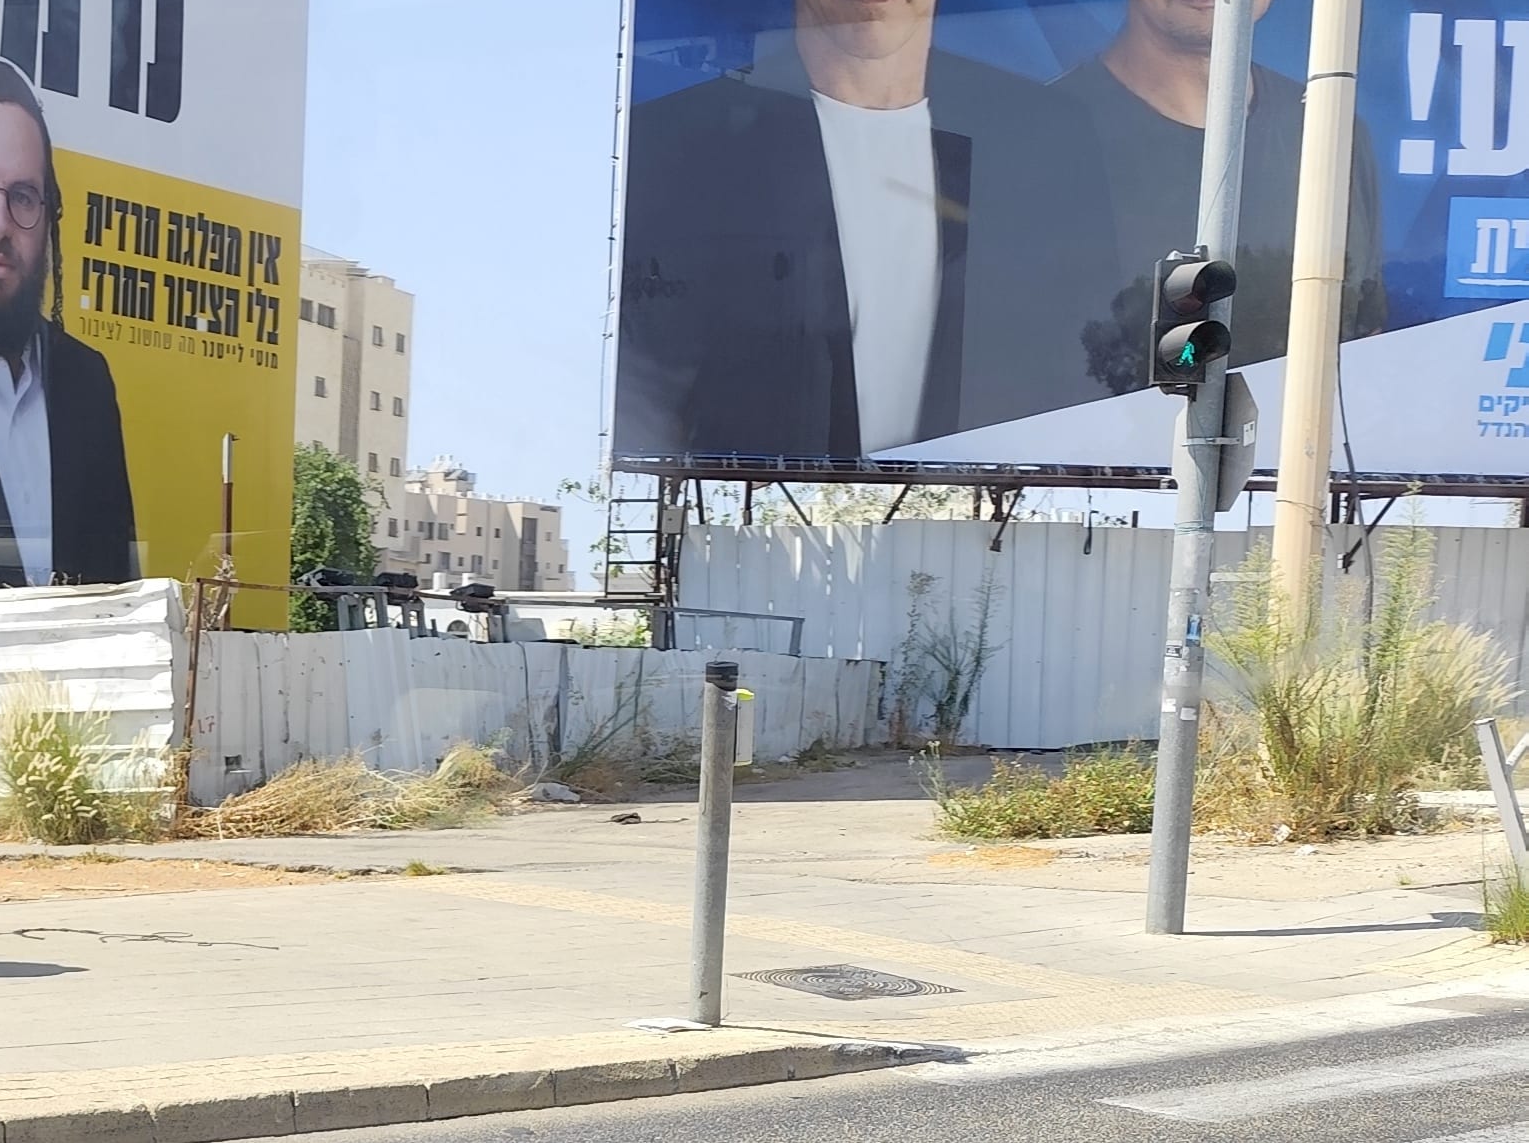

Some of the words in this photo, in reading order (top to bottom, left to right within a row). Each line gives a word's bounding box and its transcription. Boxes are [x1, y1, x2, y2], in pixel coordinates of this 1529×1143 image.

[84, 191, 161, 259] חרדית
[166, 211, 242, 277] מפלגה
[248, 230, 282, 287] אין
[79, 316, 122, 341] לציבור
[164, 274, 240, 338] הציבור
[246, 288, 280, 345] בלי
[128, 326, 173, 349] שחשוב
[178, 335, 195, 354] מה
